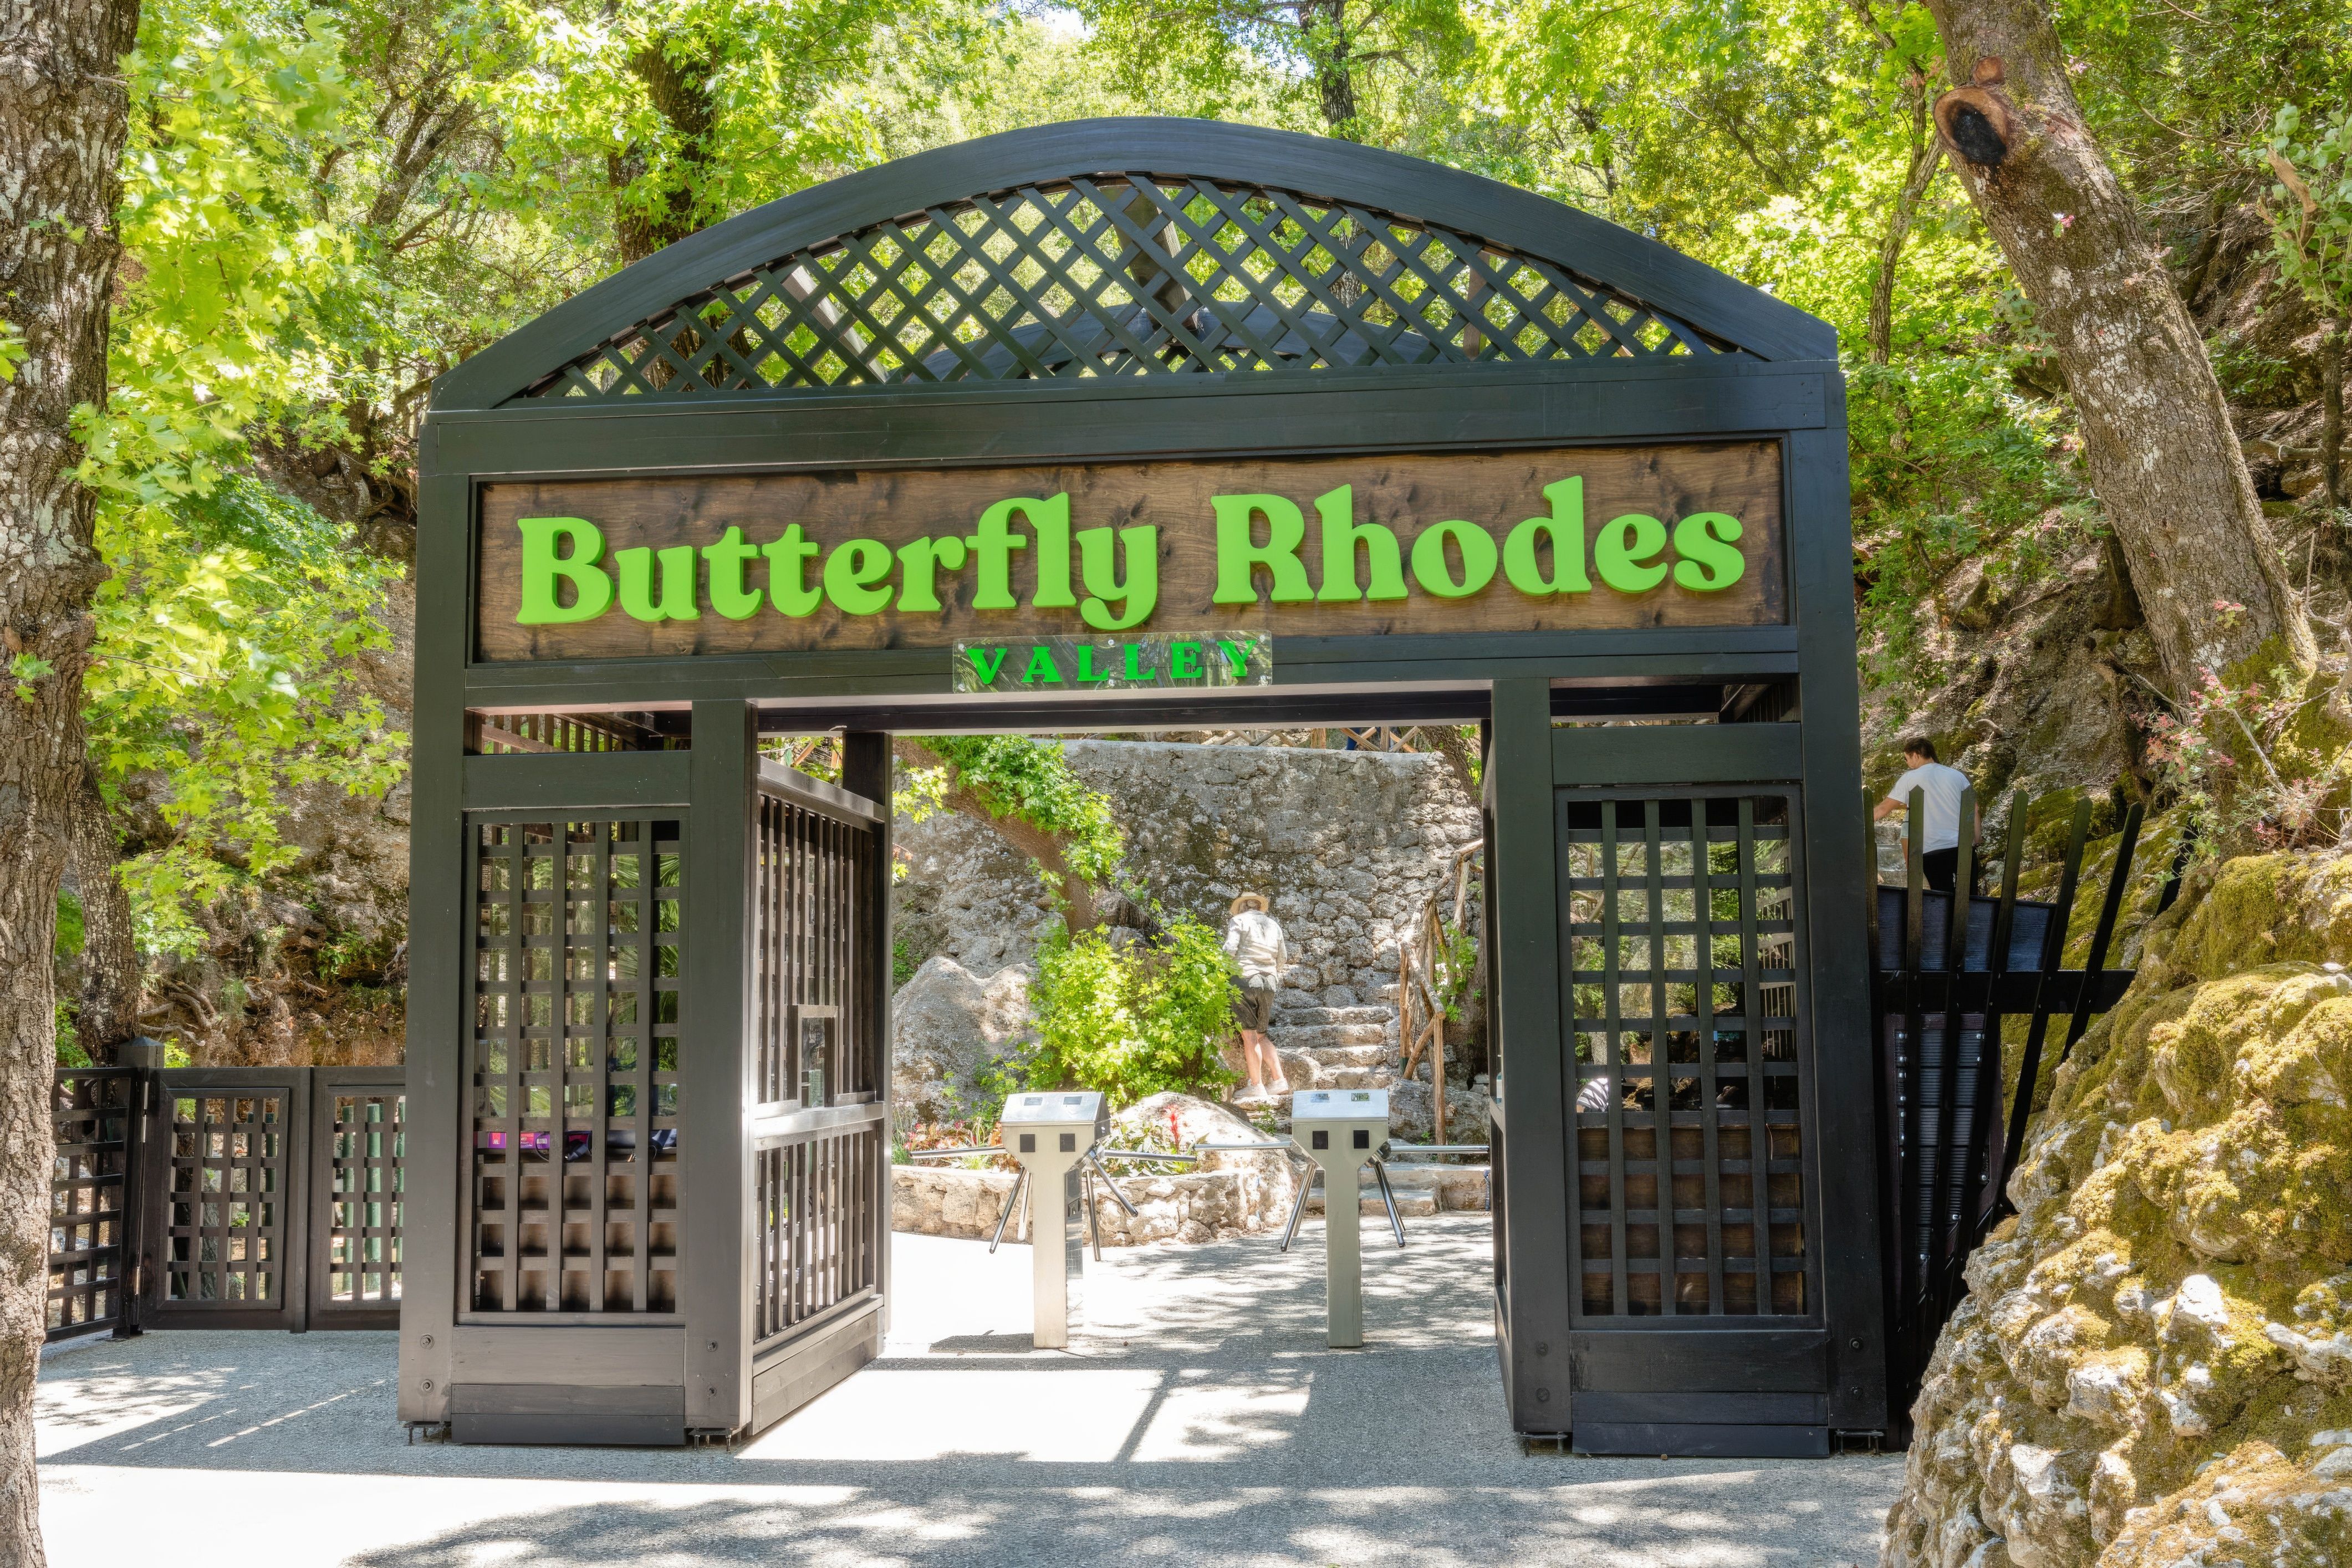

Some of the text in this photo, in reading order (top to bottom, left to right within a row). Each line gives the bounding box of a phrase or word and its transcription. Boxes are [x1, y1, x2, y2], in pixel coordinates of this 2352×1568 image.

[517, 476, 1744, 630] Butterfly Rhodes
[966, 640, 1257, 685] VALLEY
